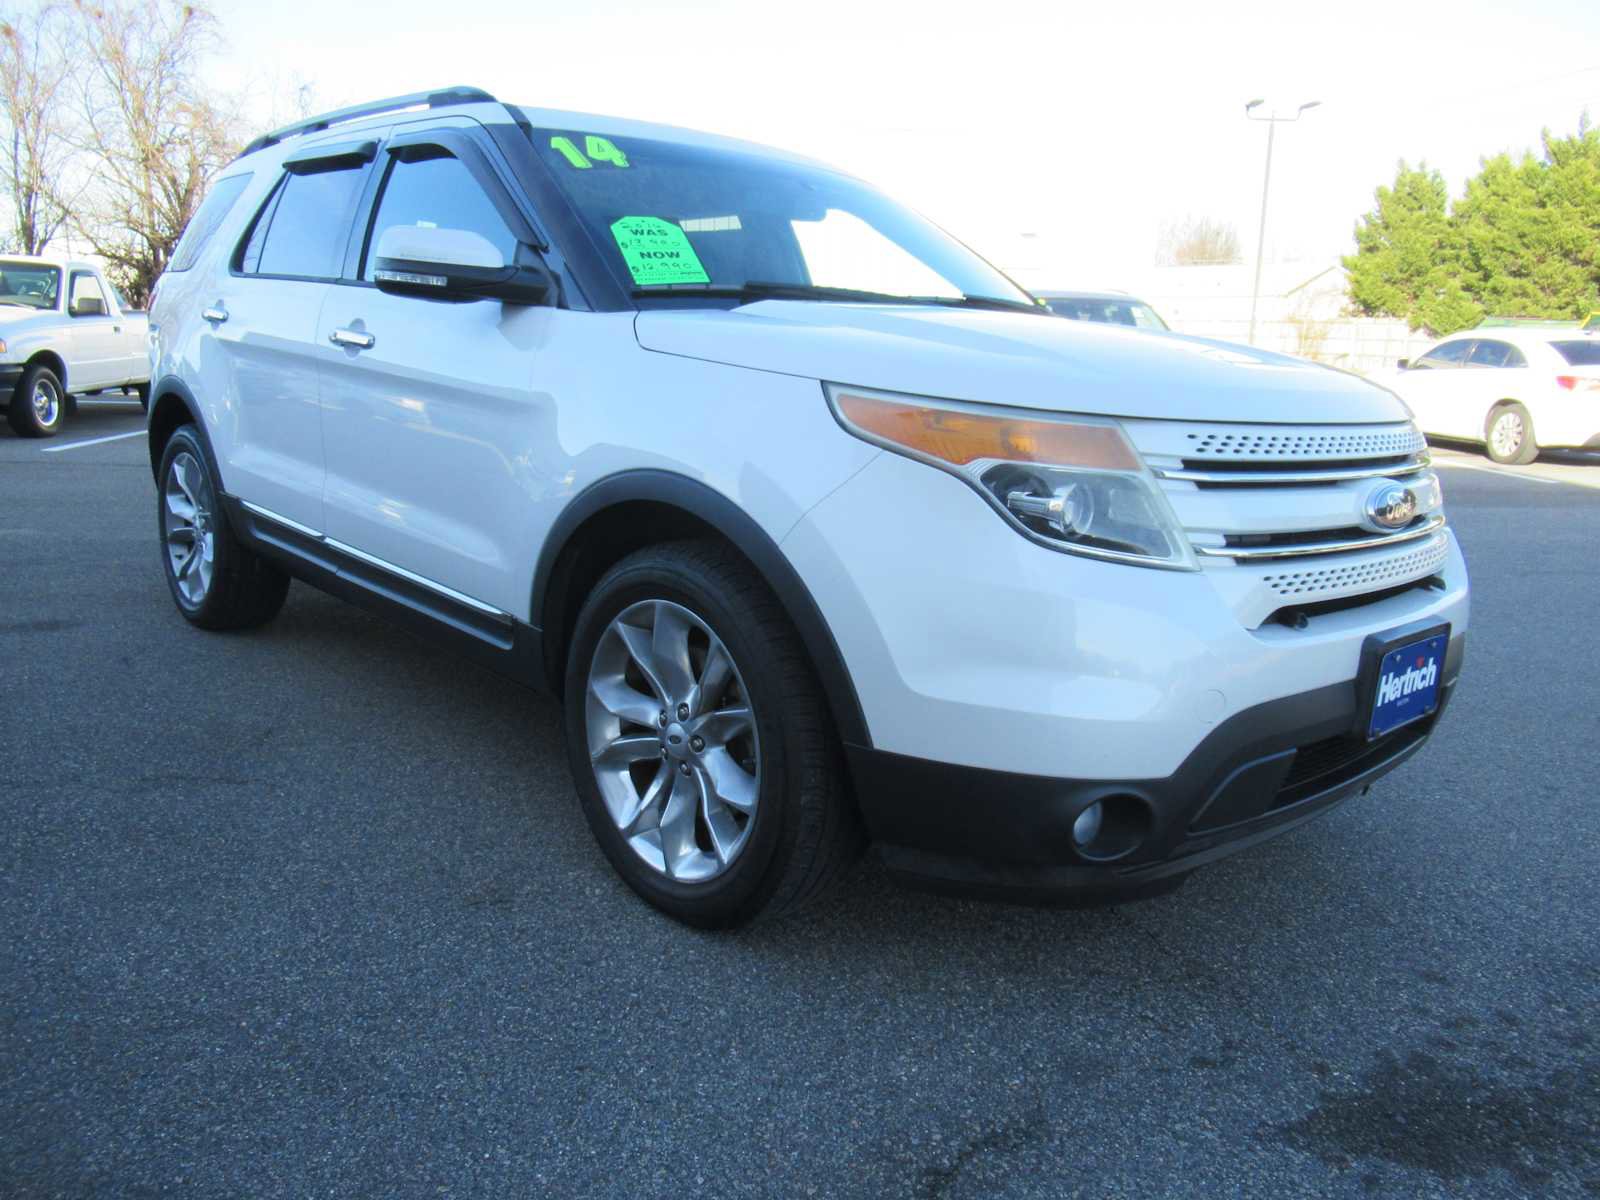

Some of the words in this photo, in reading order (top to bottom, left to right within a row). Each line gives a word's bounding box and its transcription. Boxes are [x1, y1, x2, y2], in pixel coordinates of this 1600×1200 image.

[550, 135, 629, 168] 14
[639, 251, 680, 259] NOW
[1376, 656, 1437, 707] Hertrich
